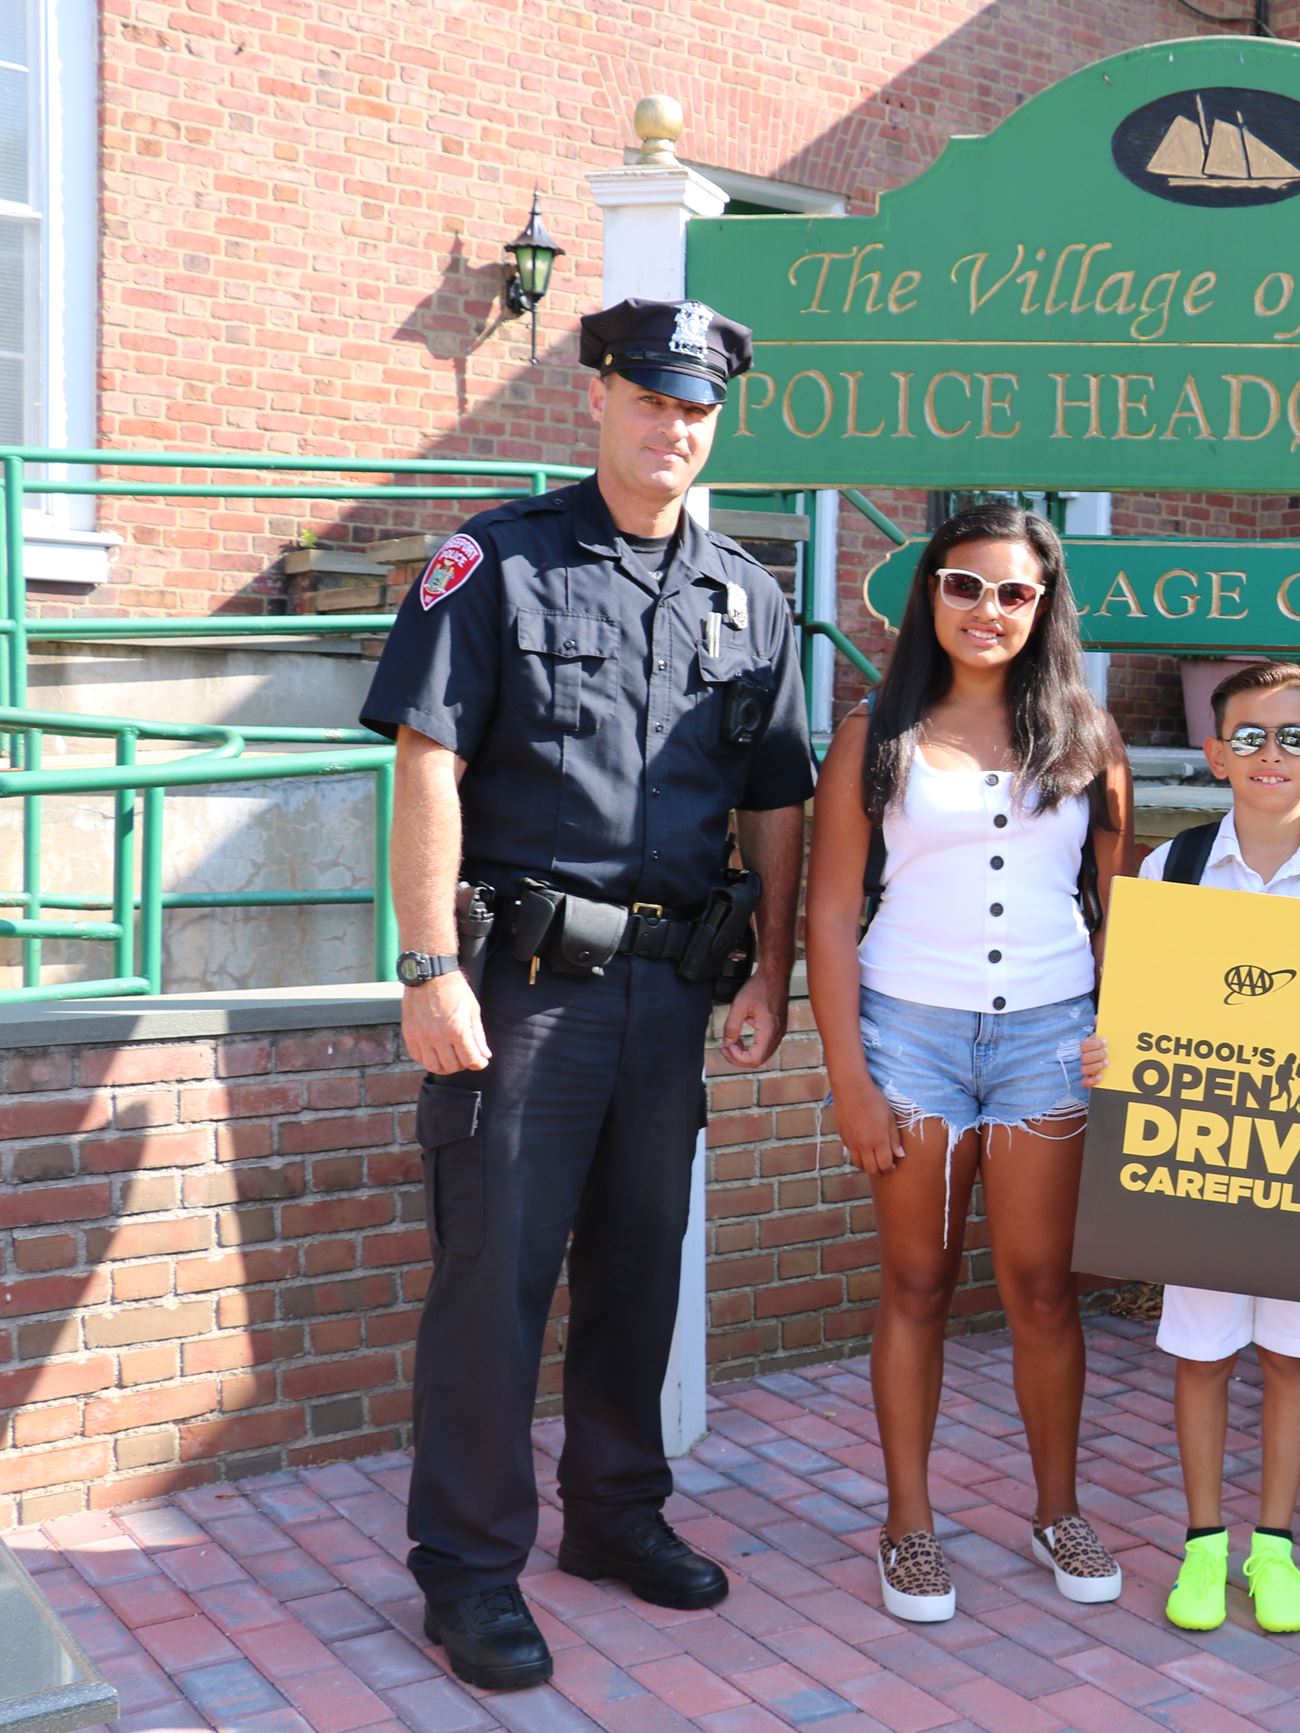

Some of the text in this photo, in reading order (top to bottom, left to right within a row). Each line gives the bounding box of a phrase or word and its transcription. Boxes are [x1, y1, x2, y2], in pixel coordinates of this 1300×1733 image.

[788, 243, 922, 315] The
[951, 243, 1217, 340] Village
[732, 370, 1021, 439] POLICE
[1136, 1032, 1276, 1068] SCHOOL'S
[1132, 1059, 1274, 1111] OPEN
